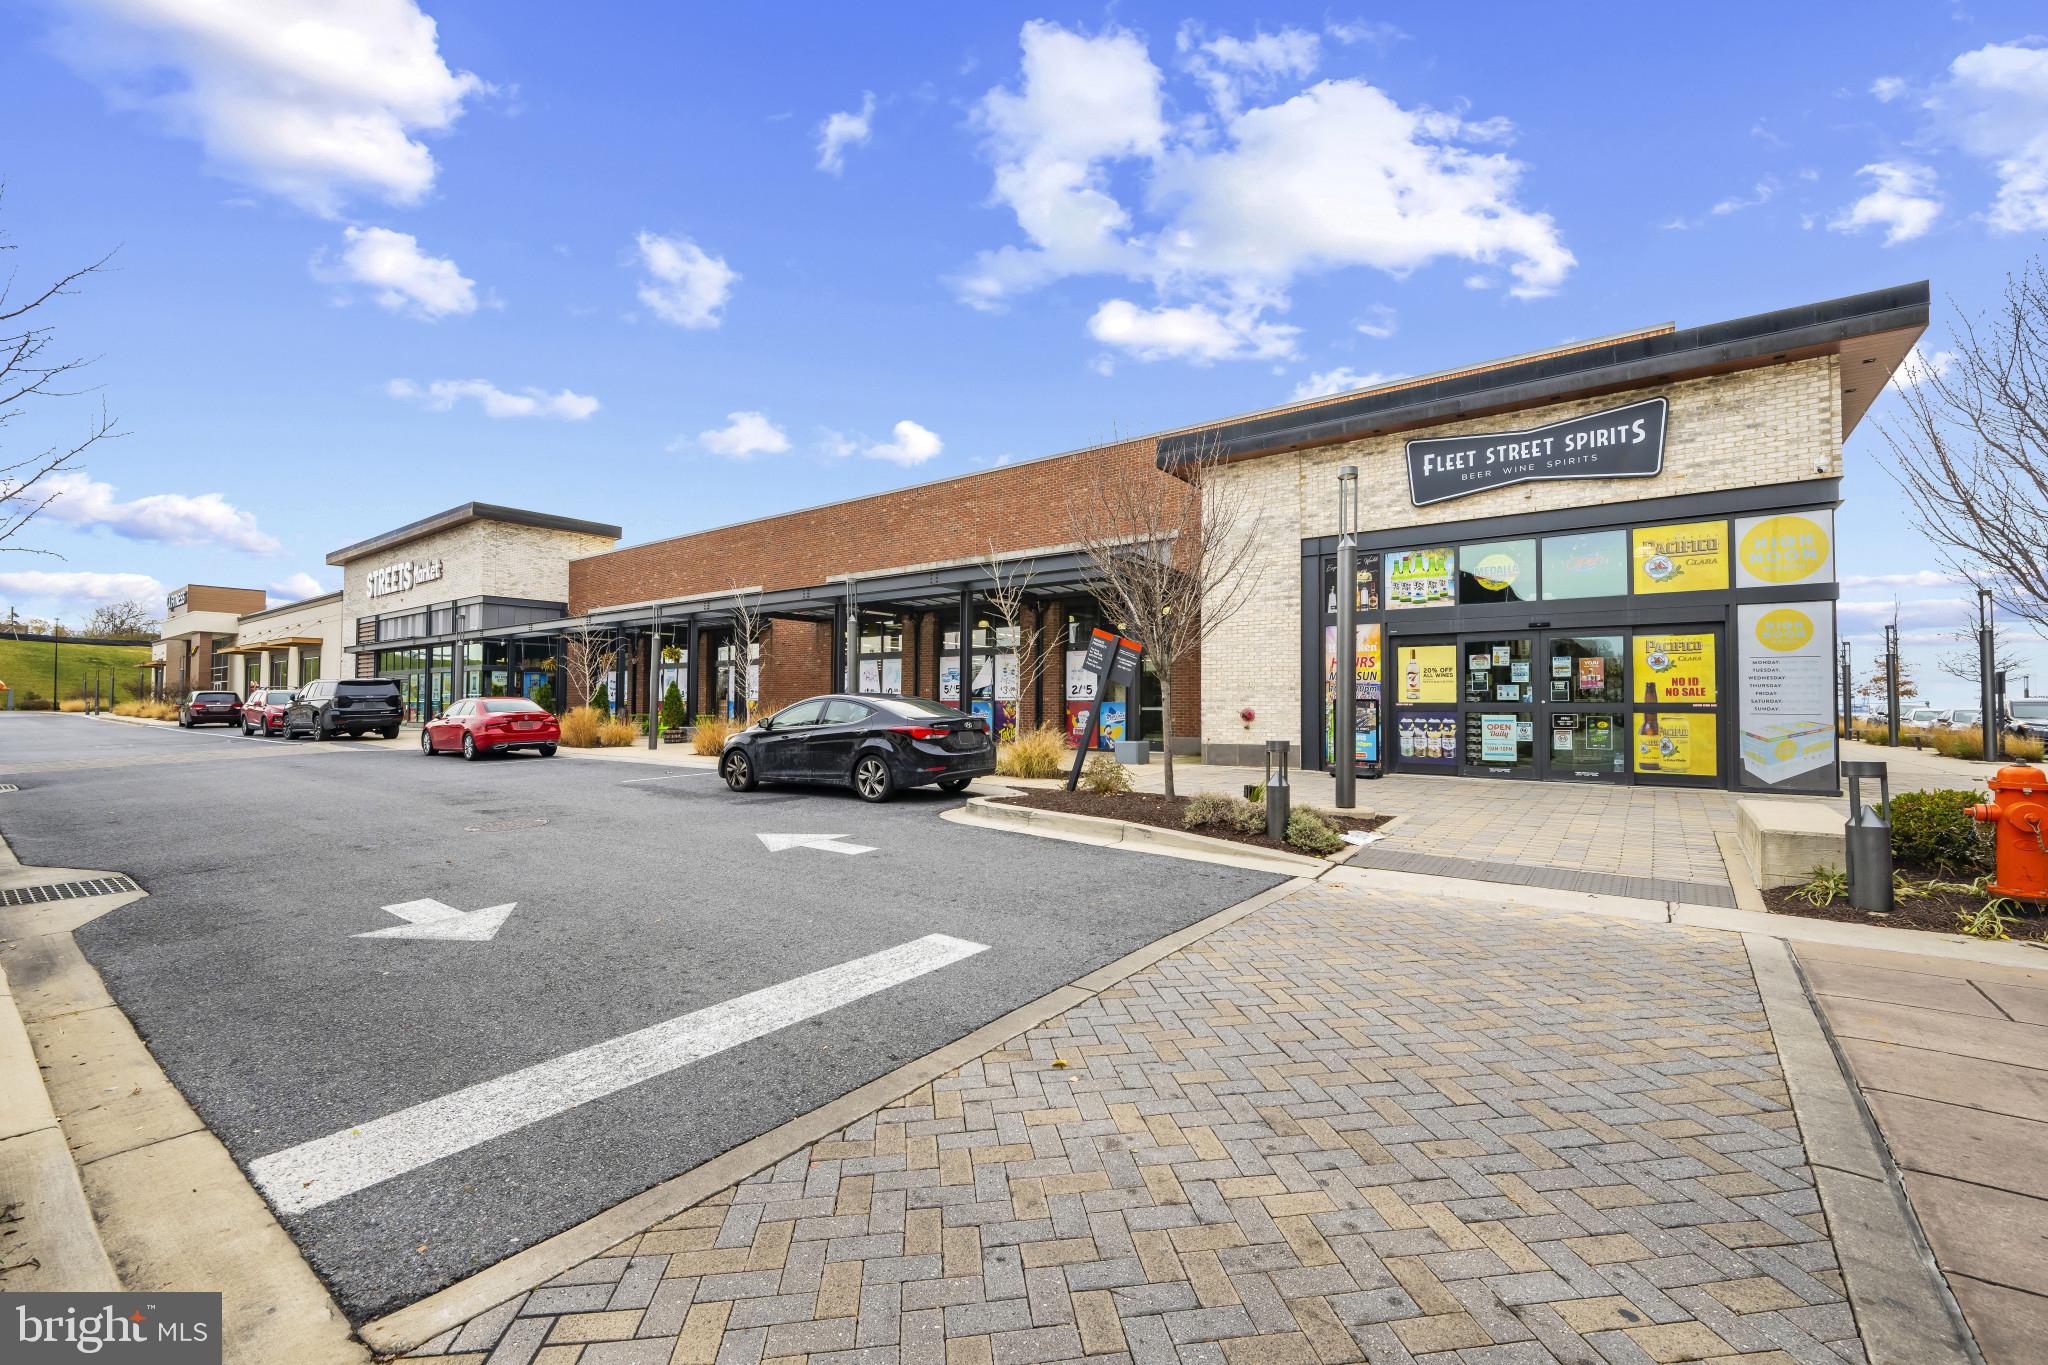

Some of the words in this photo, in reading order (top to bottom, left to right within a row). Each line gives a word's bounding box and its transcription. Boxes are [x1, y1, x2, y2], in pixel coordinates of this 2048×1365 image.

[1423, 450, 1476, 476] FLEET
[1486, 437, 1554, 464] STREET
[1565, 418, 1646, 451] SPIRITS
[1461, 470, 1492, 481] BEER
[1502, 463, 1535, 475] WINE
[1546, 455, 1598, 469] SPIRITS
[1643, 538, 1719, 557] PACIFICO
[1754, 534, 1814, 549] HIGH
[1750, 548, 1817, 564] NOON
[1473, 563, 1520, 577] MEDALLA
[367, 562, 413, 598] STREETS
[1645, 640, 1702, 654] PACIFICO
[1671, 677, 1686, 686] NO
[1688, 676, 1699, 686] ID
[1665, 687, 1680, 696] NO
[1682, 687, 1706, 696] SALE
[1487, 723, 1511, 731] OPEN
[1490, 730, 1508, 738] Daily
